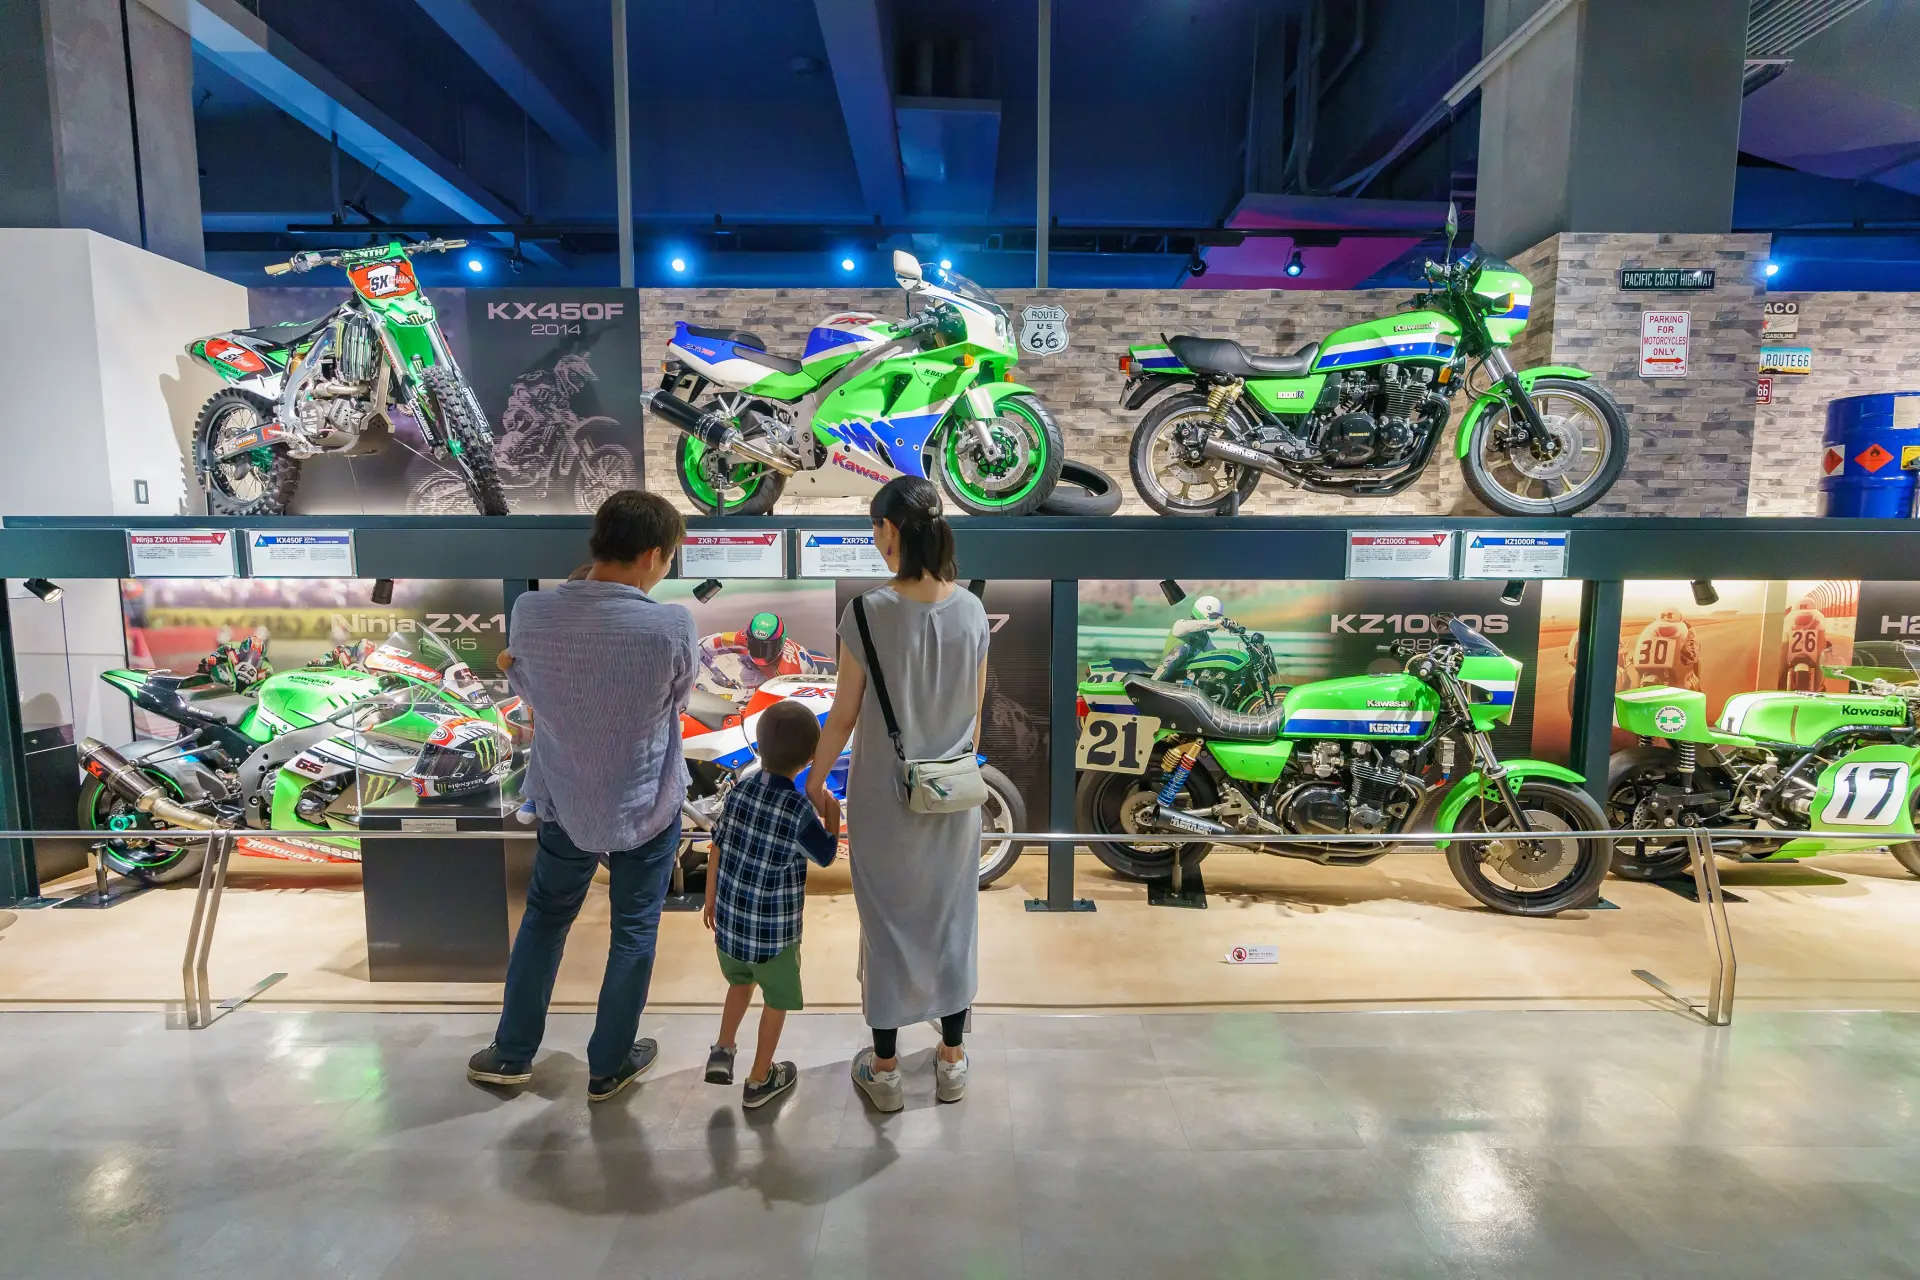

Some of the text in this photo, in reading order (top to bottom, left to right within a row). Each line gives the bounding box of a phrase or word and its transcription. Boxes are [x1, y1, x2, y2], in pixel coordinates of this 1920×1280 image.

[370, 274, 389, 291] SX
[1624, 273, 1713, 287] PACIFIC COAST HIGHWAY
[487, 302, 624, 320] KX450F
[1032, 311, 1059, 319] ROUTE
[1764, 303, 1797, 314] ACO
[1649, 316, 1684, 324] PARKING
[531, 324, 582, 336] 2014
[1394, 322, 1440, 333] Kawasaki
[1657, 326, 1675, 334] FOR
[1031, 332, 1059, 349] 66
[1644, 336, 1687, 345] MOTORCYCLES
[1653, 348, 1676, 356] ONLY
[213, 360, 242, 377] Kawasaki
[1757, 384, 1769, 396] 66
[832, 451, 890, 484] Kawas
[136, 536, 154, 544] Ninja
[330, 613, 506, 637] Ninja ZX-1
[1330, 614, 1509, 634] KZ100S
[1791, 631, 1816, 653] 26
[1638, 639, 1669, 665] 30
[1087, 673, 1116, 683] 21
[1367, 699, 1414, 708] Kawasaki
[1842, 704, 1904, 718] Kawasaki
[1369, 722, 1411, 734] KERKER
[1086, 719, 1141, 769] 21
[295, 757, 324, 775] 65
[1835, 766, 1902, 820] 17
[276, 836, 361, 861] Kawasak
